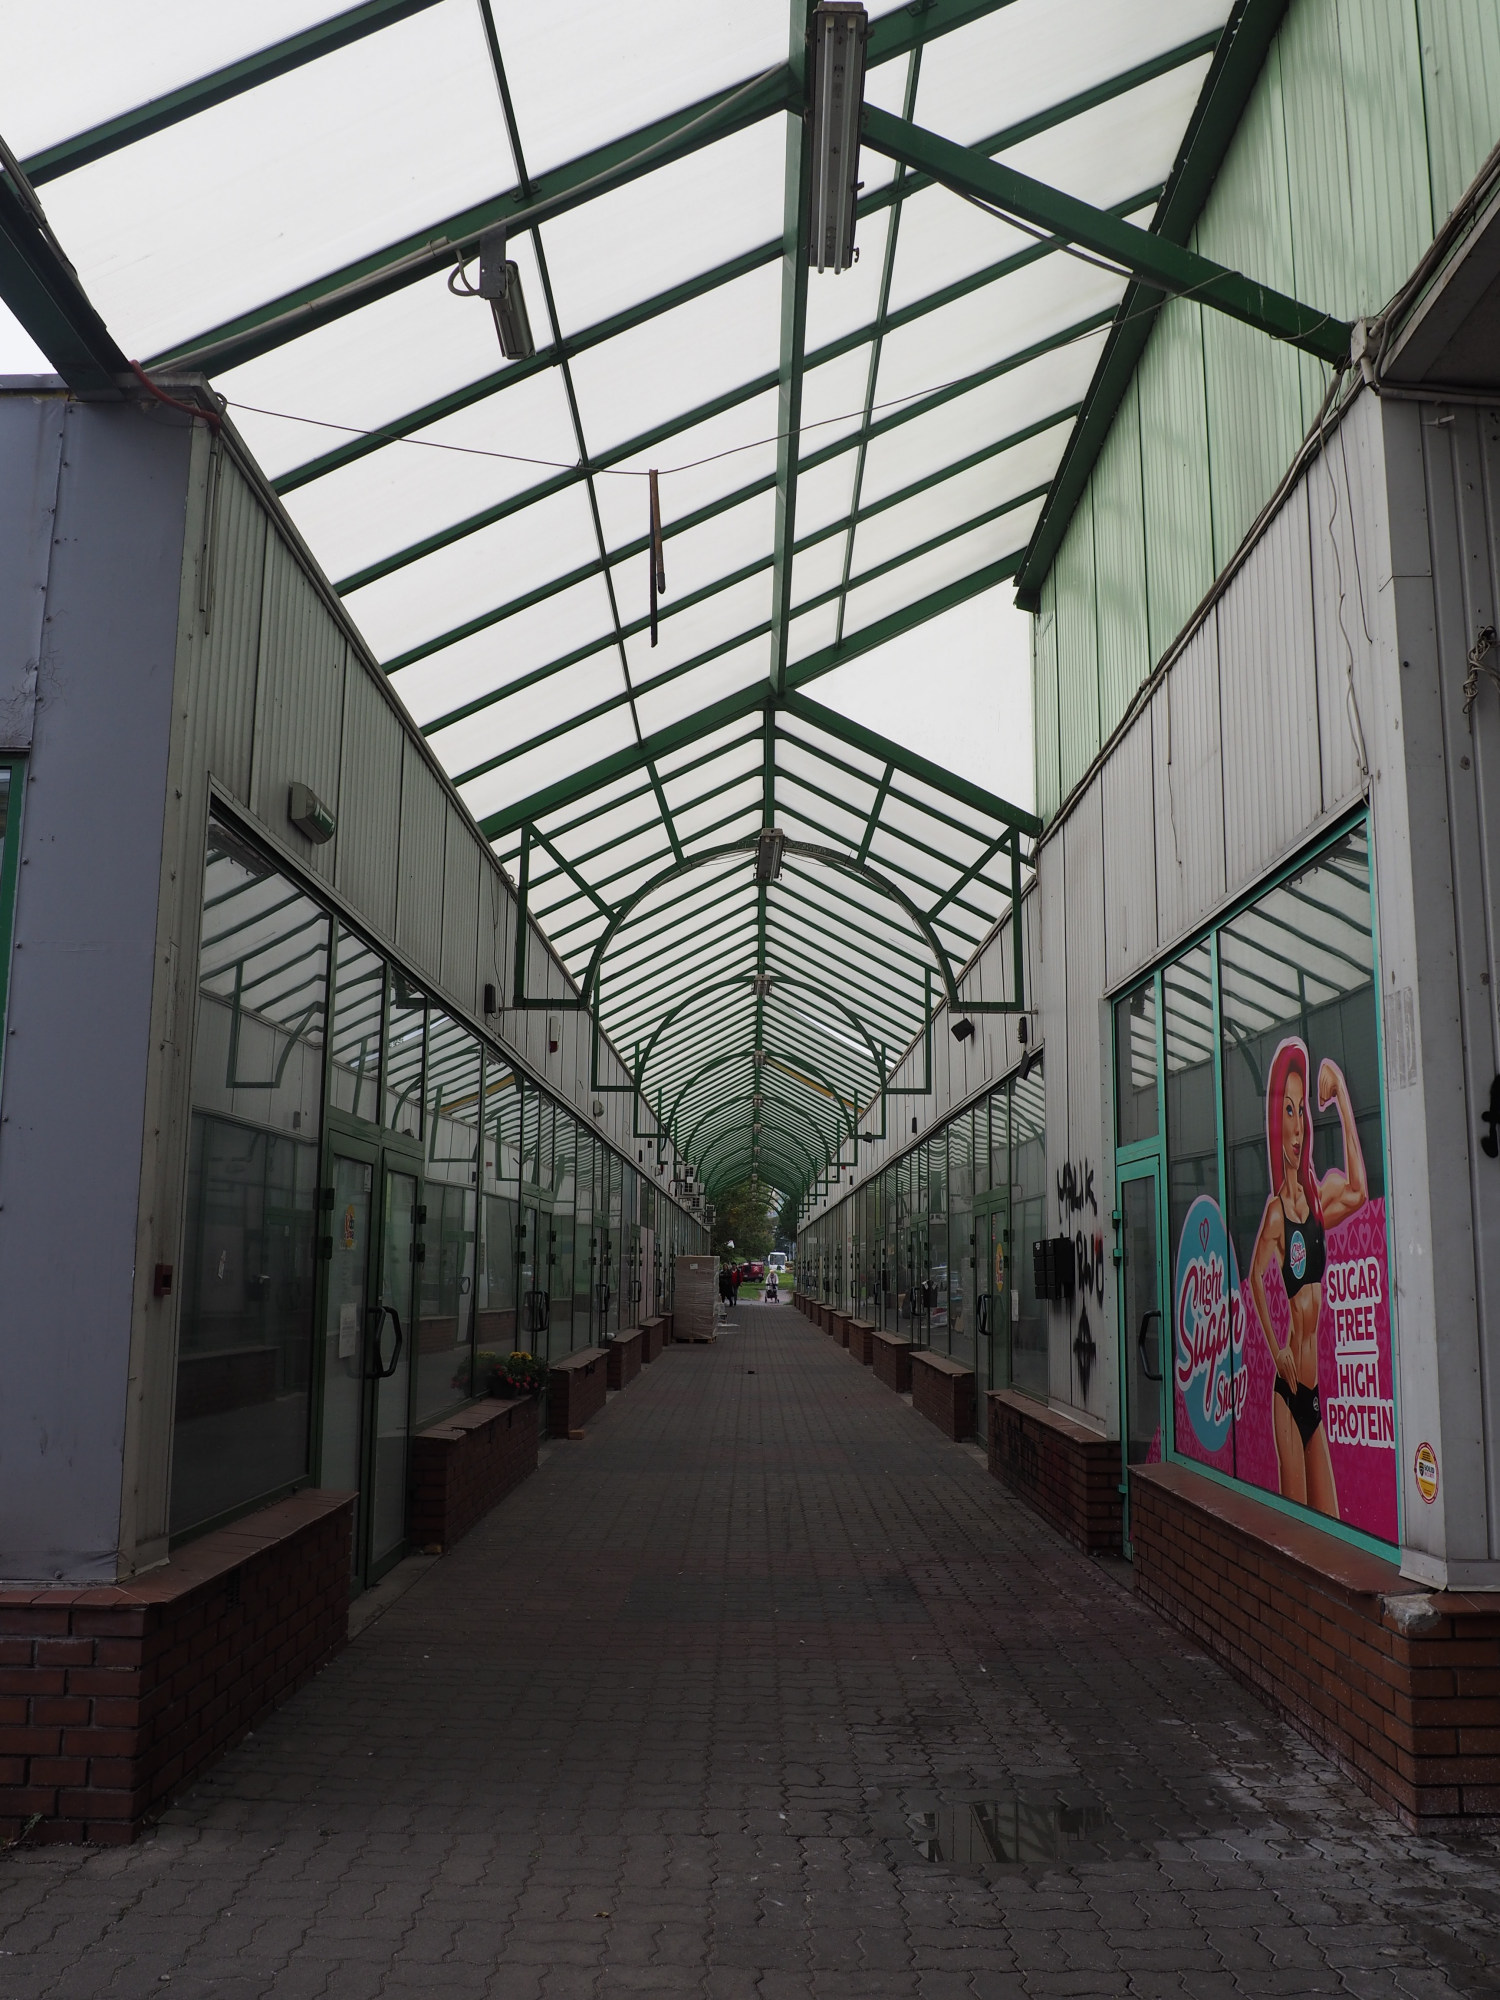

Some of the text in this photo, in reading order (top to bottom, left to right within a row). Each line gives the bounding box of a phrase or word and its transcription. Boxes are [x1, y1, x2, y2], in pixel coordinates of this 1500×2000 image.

[1328, 1263, 1379, 1303] SUGAR
[1178, 1265, 1244, 1412] Sugar
[1337, 1306, 1374, 1342] FREE
[1215, 1369, 1246, 1421] Shop
[1339, 1363, 1377, 1398] HIGH
[1328, 1404, 1395, 1442] PROTEIN
